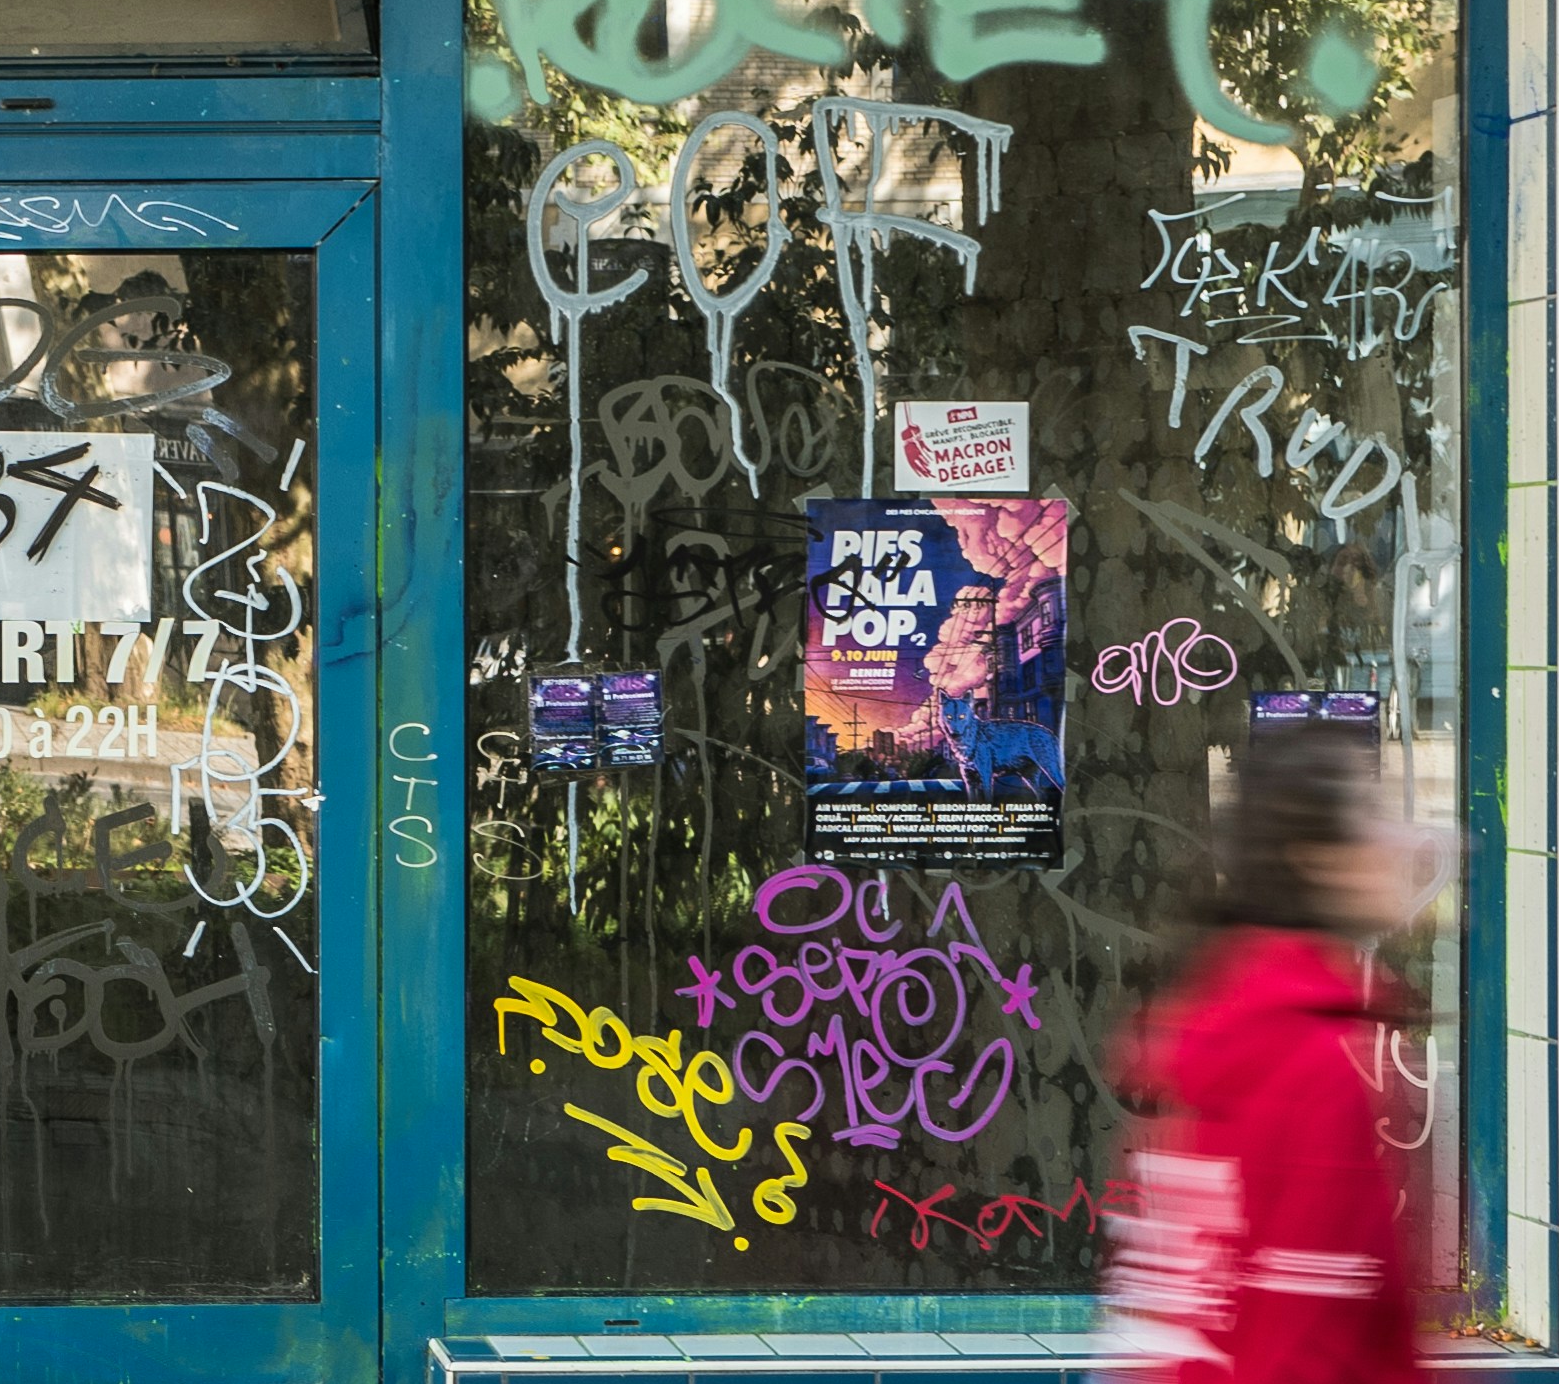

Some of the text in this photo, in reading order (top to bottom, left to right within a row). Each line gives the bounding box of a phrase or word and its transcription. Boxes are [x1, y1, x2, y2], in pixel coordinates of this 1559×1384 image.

[970, 428, 1010, 439] BLOCAGES
[934, 437, 1012, 464] MACRON
[938, 457, 1006, 483] DÉGAGE
[831, 530, 923, 568] PIES
[826, 570, 937, 607] PALA
[822, 609, 917, 647] POP
[864, 650, 898, 661] JUIN
[849, 668, 896, 678] RENNES
[29, 707, 53, 759] à
[65, 704, 158, 759] 22H
[815, 803, 831, 812] AIR
[832, 803, 862, 812] WAVES
[875, 803, 918, 812] COMFORT
[1006, 803, 1033, 811] ITALIA
[964, 814, 1004, 822] PEACOCK
[815, 824, 852, 833] RADICAL
[853, 824, 882, 833] KITTEN
[892, 824, 918, 833] WHAT
[919, 824, 934, 833] ARE
[935, 824, 966, 833] PEOPLE
